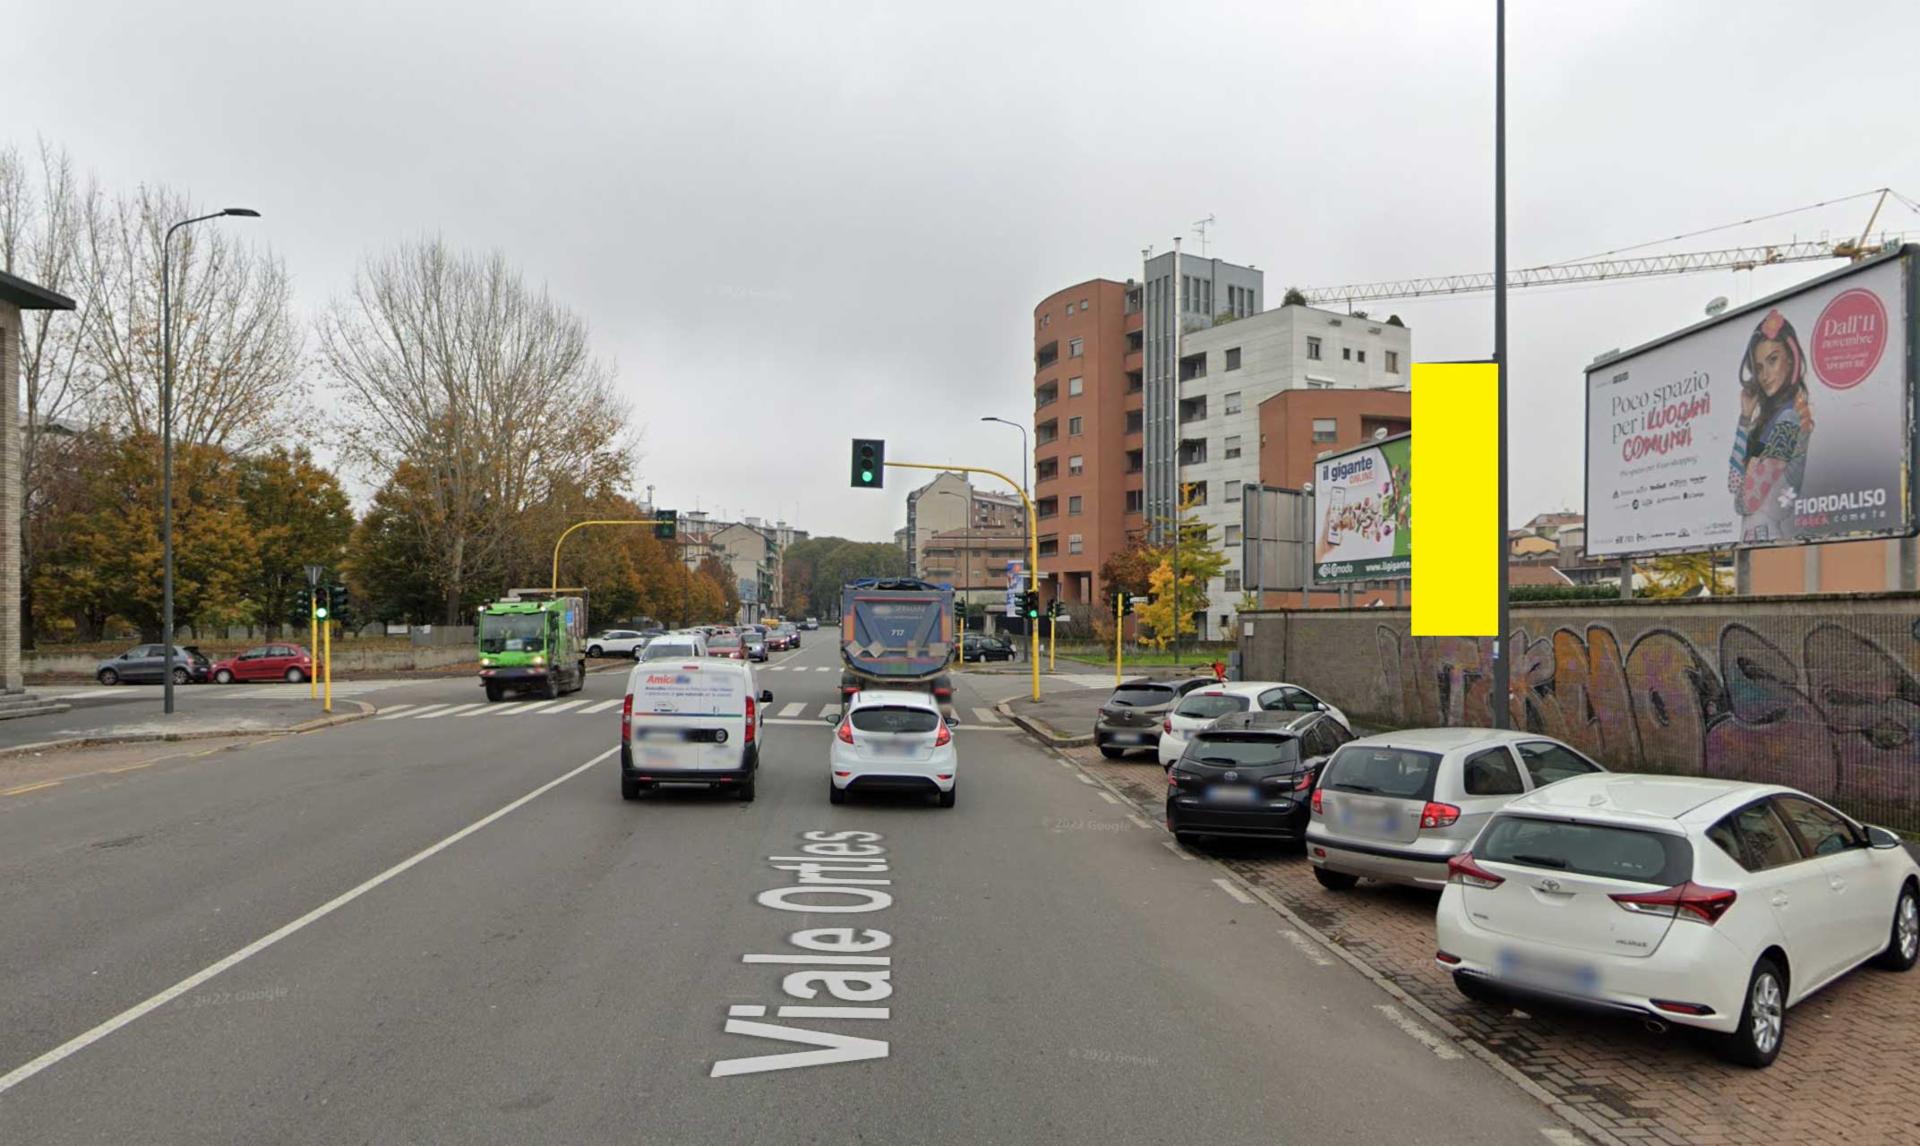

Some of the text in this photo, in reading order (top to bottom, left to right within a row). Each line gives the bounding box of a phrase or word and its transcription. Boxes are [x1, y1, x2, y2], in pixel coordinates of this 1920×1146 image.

[1612, 392, 1649, 417] Poco
[1653, 370, 1710, 409] spazio
[1612, 417, 1638, 445] per
[1322, 456, 1373, 482] il gigante
[1794, 488, 1887, 516] FIORDALISO
